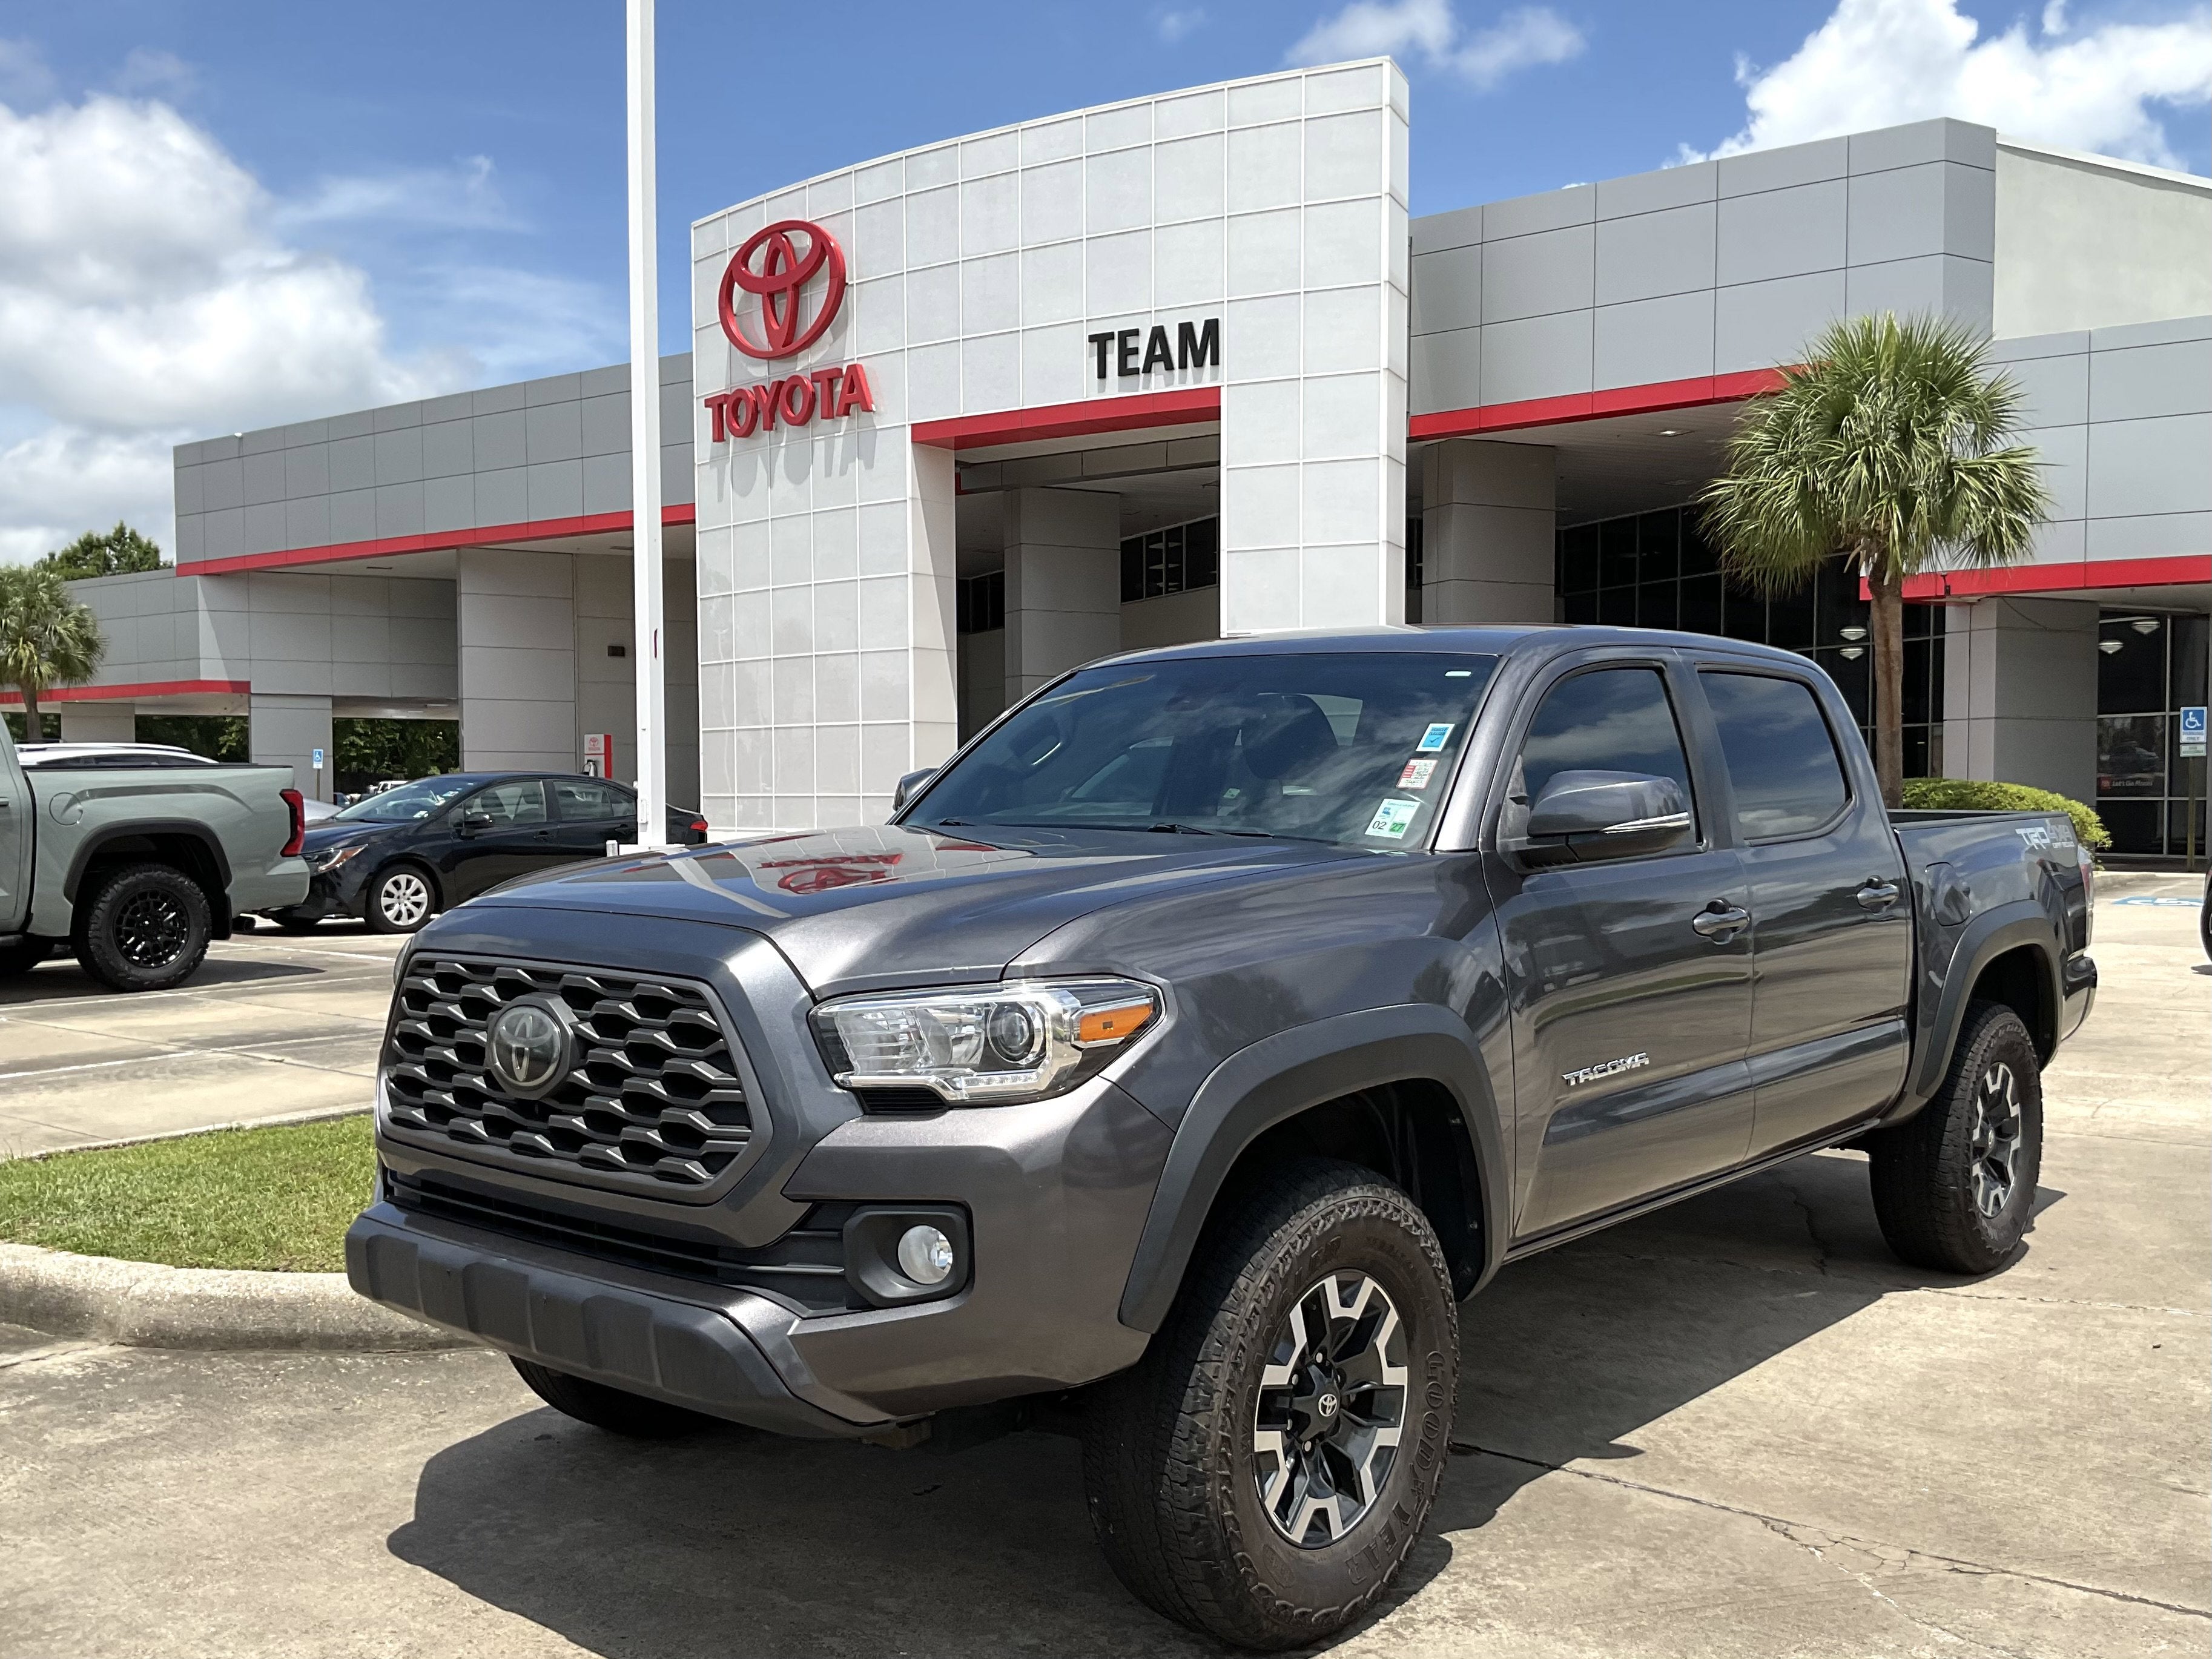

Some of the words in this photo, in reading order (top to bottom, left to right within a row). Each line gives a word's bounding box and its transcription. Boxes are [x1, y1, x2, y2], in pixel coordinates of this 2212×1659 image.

[1088, 318, 1220, 379] TEAM
[704, 363, 874, 443] TOYOTA
[1372, 820, 1387, 830] 02
[1389, 822, 1405, 832] 27
[1560, 1051, 1650, 1086] TACOMA
